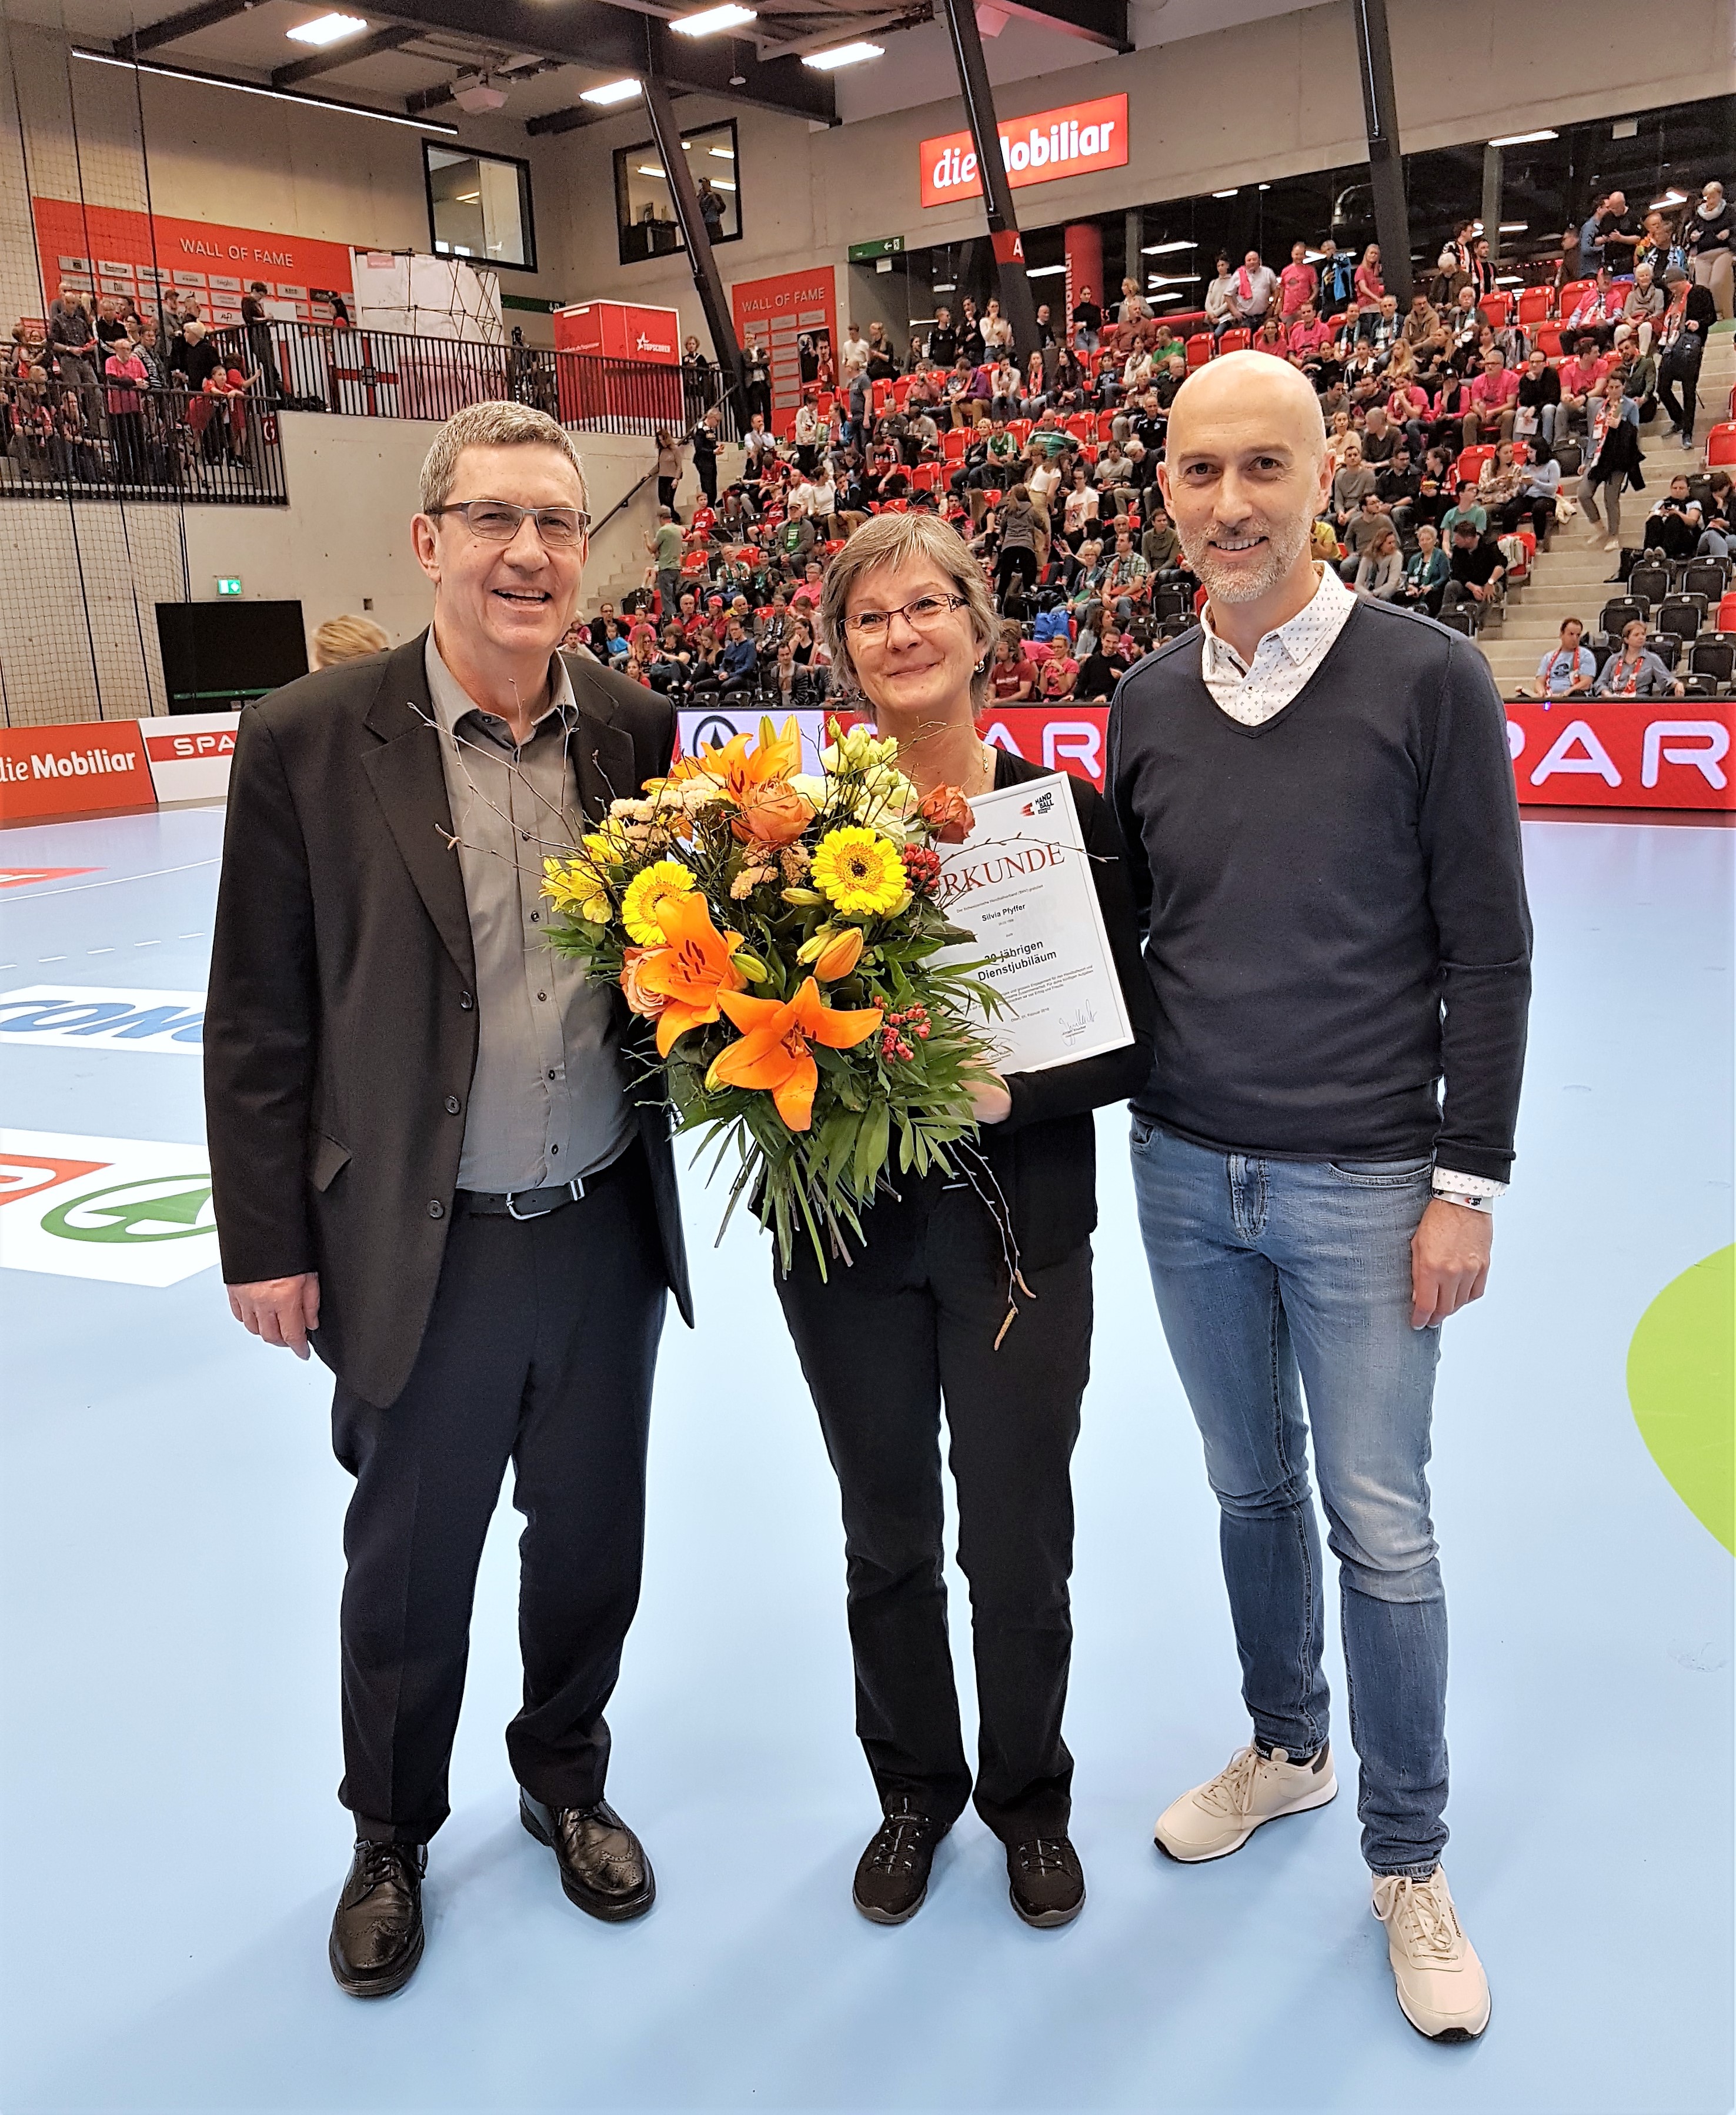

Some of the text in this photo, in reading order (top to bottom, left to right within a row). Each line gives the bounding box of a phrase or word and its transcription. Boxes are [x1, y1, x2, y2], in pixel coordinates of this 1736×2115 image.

[933, 148, 977, 188] die
[180, 238, 294, 268] WALL OF FAME
[1013, 237, 1023, 257] A
[742, 287, 825, 312] WALL OF FAME
[31, 748, 135, 779] Mobiliar
[1035, 792, 1051, 805] HAND
[1039, 799, 1054, 809] BALL
[981, 910, 1001, 922] Silvia
[1002, 903, 1026, 916] Pfyffer
[1001, 940, 1043, 962] jährigen
[978, 951, 1057, 981] Dienstjubiläum
